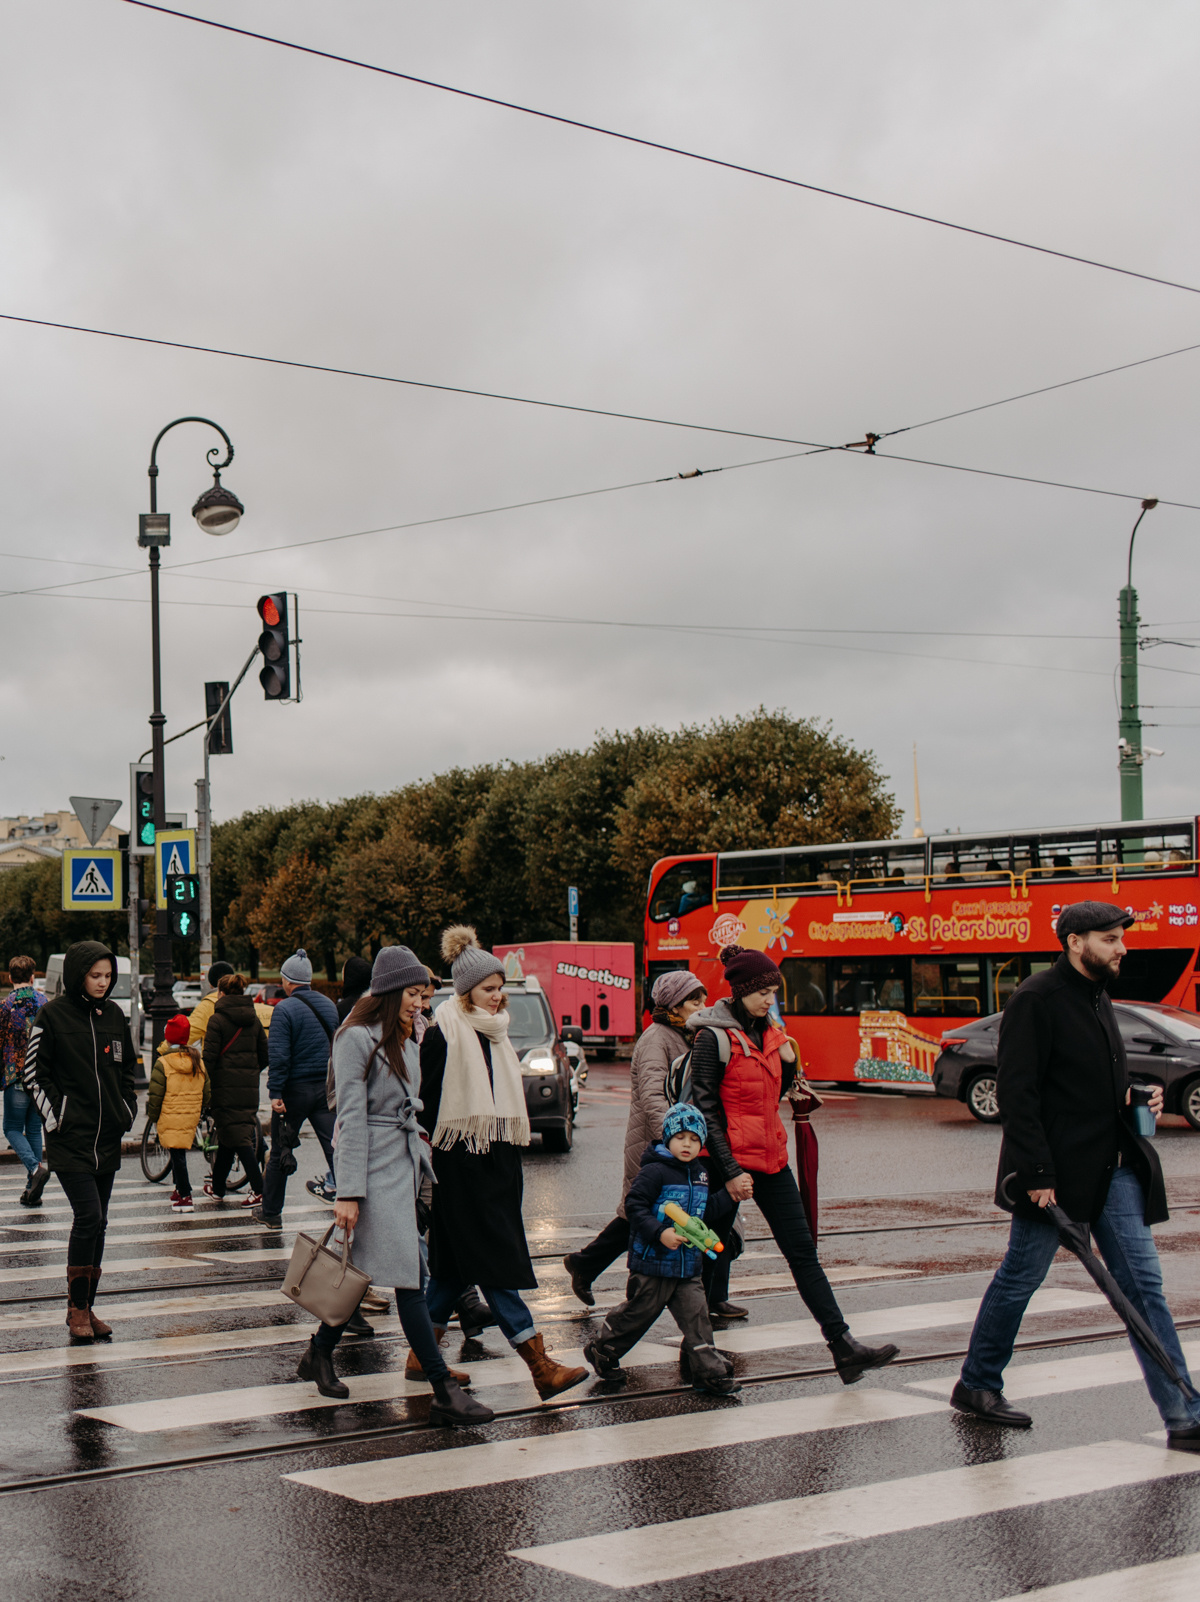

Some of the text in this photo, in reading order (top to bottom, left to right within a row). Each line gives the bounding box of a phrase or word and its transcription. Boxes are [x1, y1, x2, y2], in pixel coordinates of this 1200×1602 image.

[141, 801, 151, 817] 2
[175, 881, 194, 900] 21
[571, 890, 578, 913] P
[1168, 903, 1197, 915] Hop On
[909, 914, 1029, 942] St Petersburg
[1168, 915, 1198, 926] Hop Off
[712, 922, 745, 938] OFFICIAL
[556, 961, 631, 991] sweetbus
